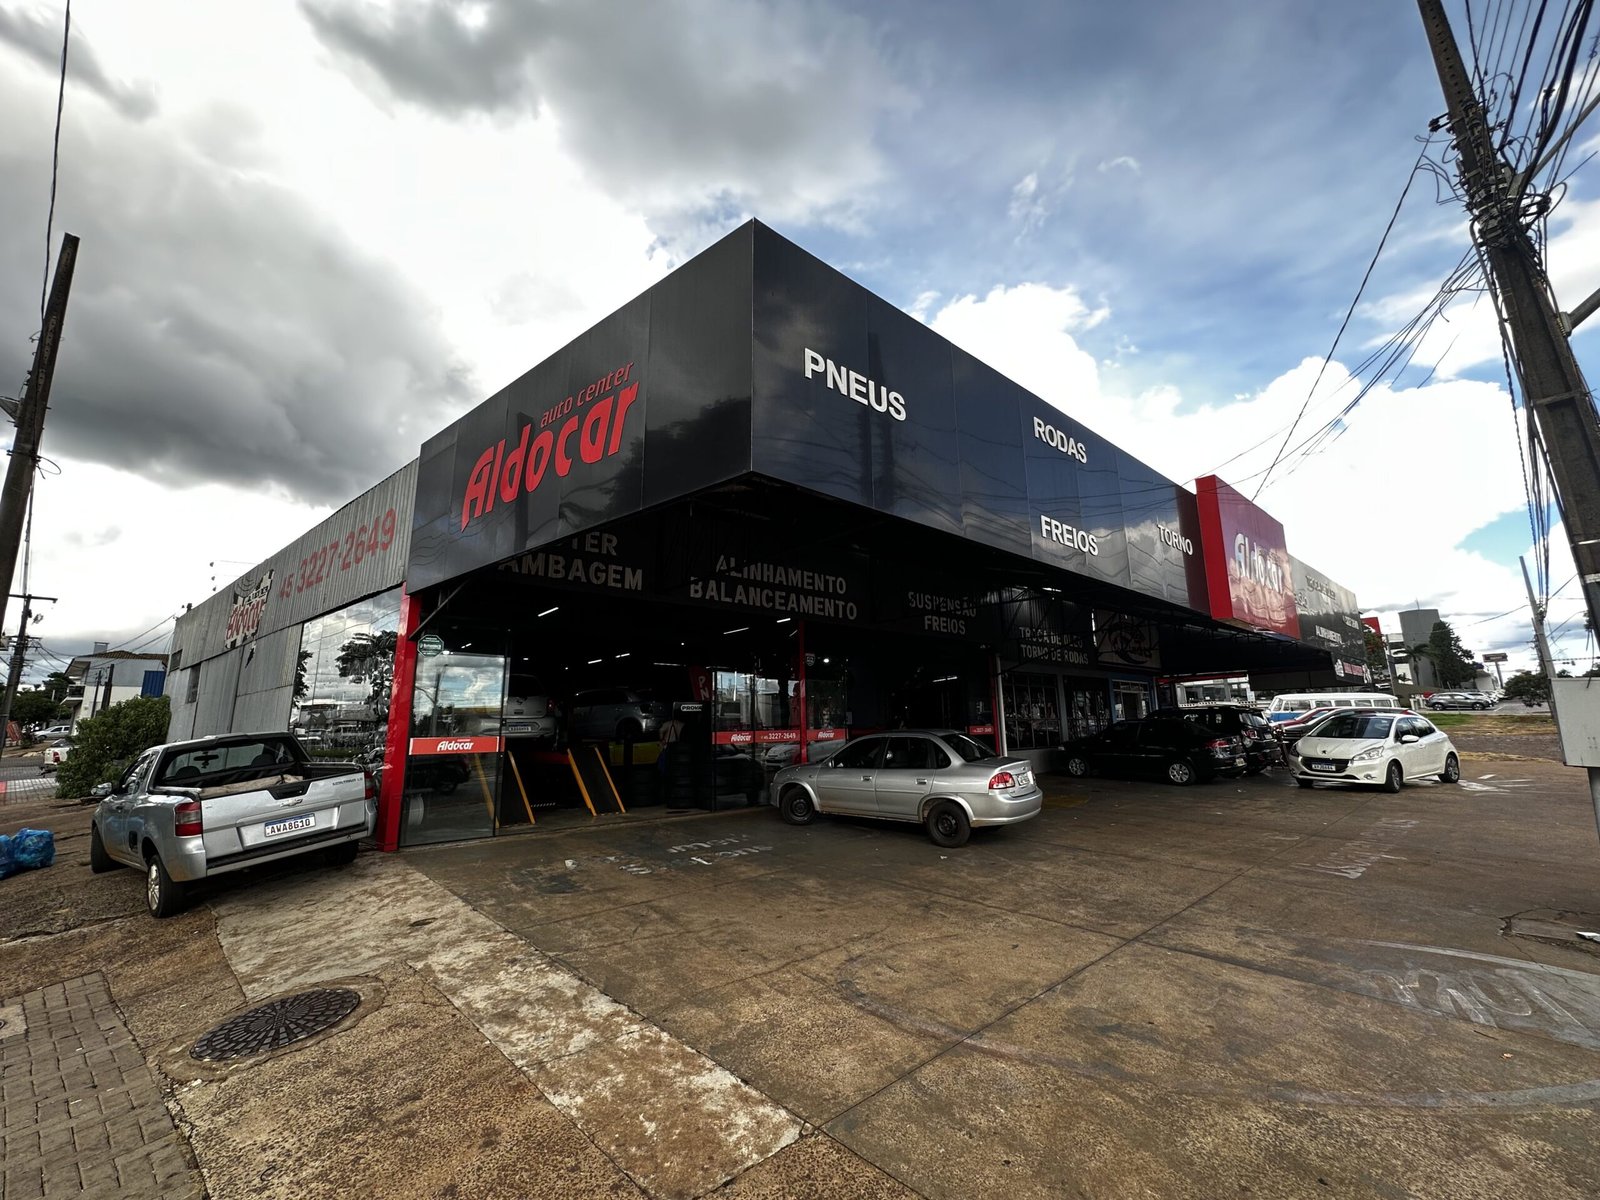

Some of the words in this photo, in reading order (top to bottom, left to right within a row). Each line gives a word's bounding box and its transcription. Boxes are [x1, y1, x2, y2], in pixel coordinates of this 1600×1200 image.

[540, 396, 573, 428] auto
[577, 362, 634, 407] center
[804, 347, 907, 421] PNEUS
[461, 381, 639, 533] Aldocar
[1033, 416, 1087, 464] RODAS
[279, 573, 295, 599] 45
[297, 508, 397, 593] 3227-2649
[1040, 514, 1098, 556] FREIOS
[1157, 524, 1193, 556] TORNO
[716, 554, 847, 595] ALINHAMENTO
[689, 576, 857, 621] BALANCEAMENTO
[924, 615, 966, 635] FREIOS
[437, 741, 474, 752] Aldocar
[768, 732, 796, 740] 3227-2649
